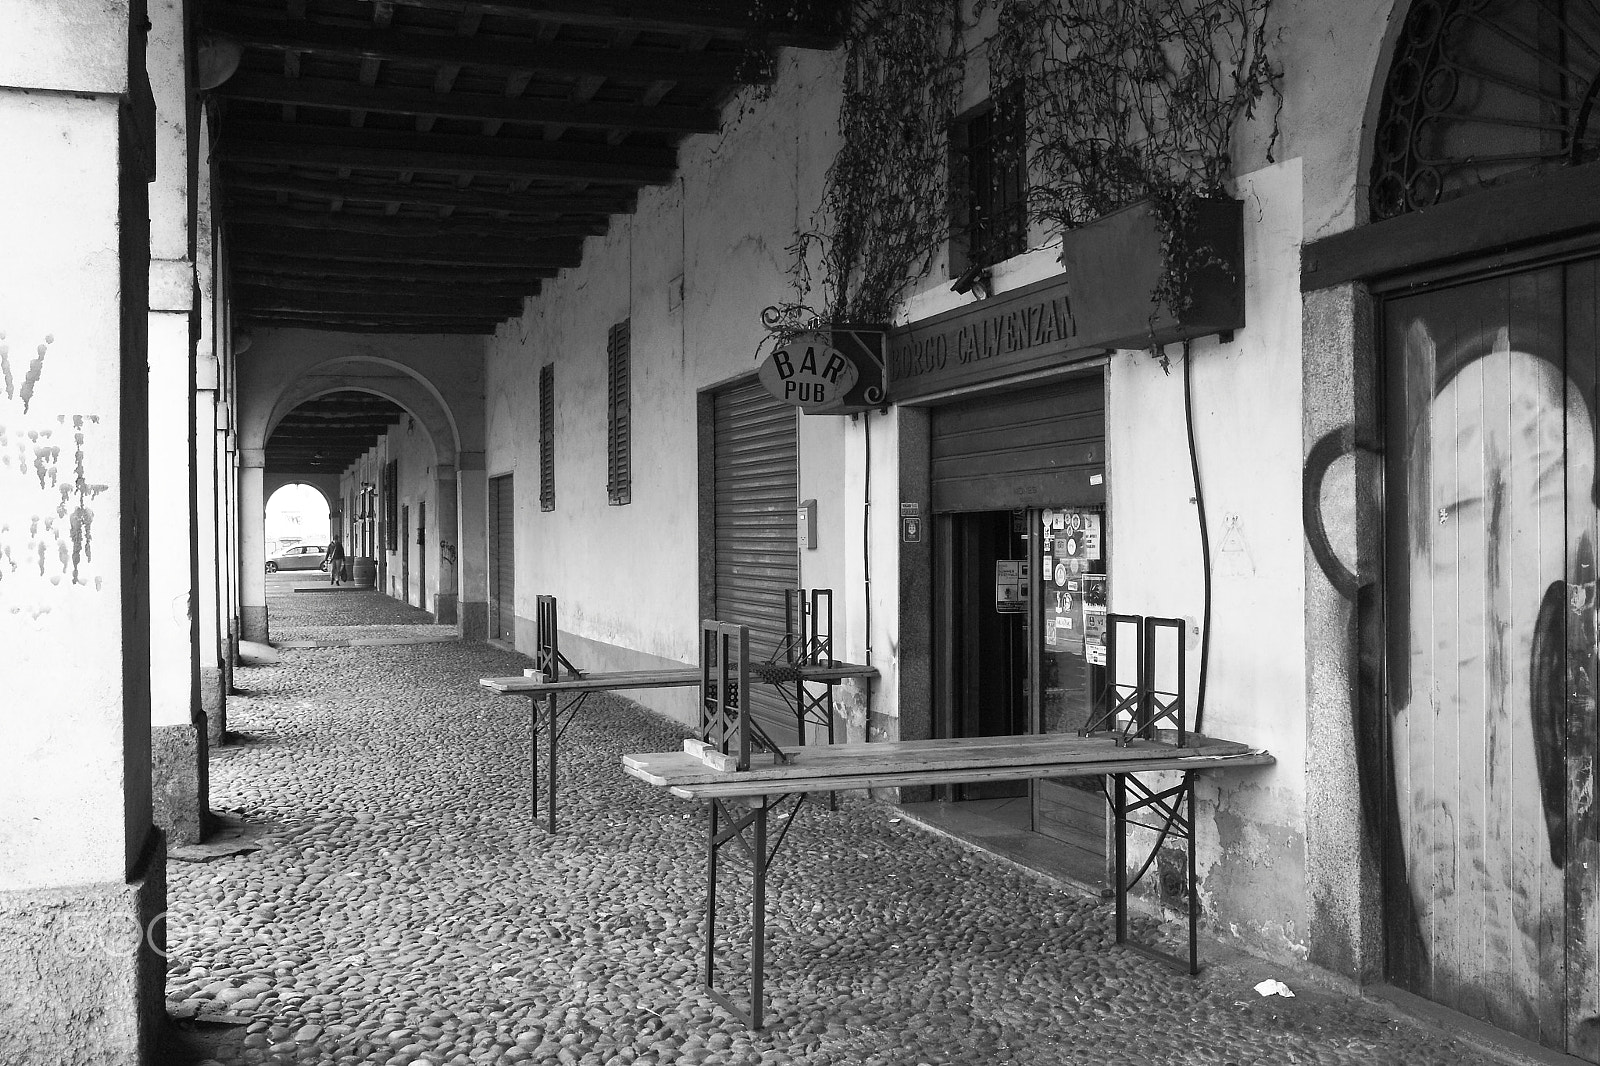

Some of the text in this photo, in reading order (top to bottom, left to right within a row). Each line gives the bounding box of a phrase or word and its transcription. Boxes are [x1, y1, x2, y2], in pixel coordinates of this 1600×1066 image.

[773, 346, 846, 384] BAR
[890, 334, 947, 382] BORGO
[784, 380, 825, 403] PUB
